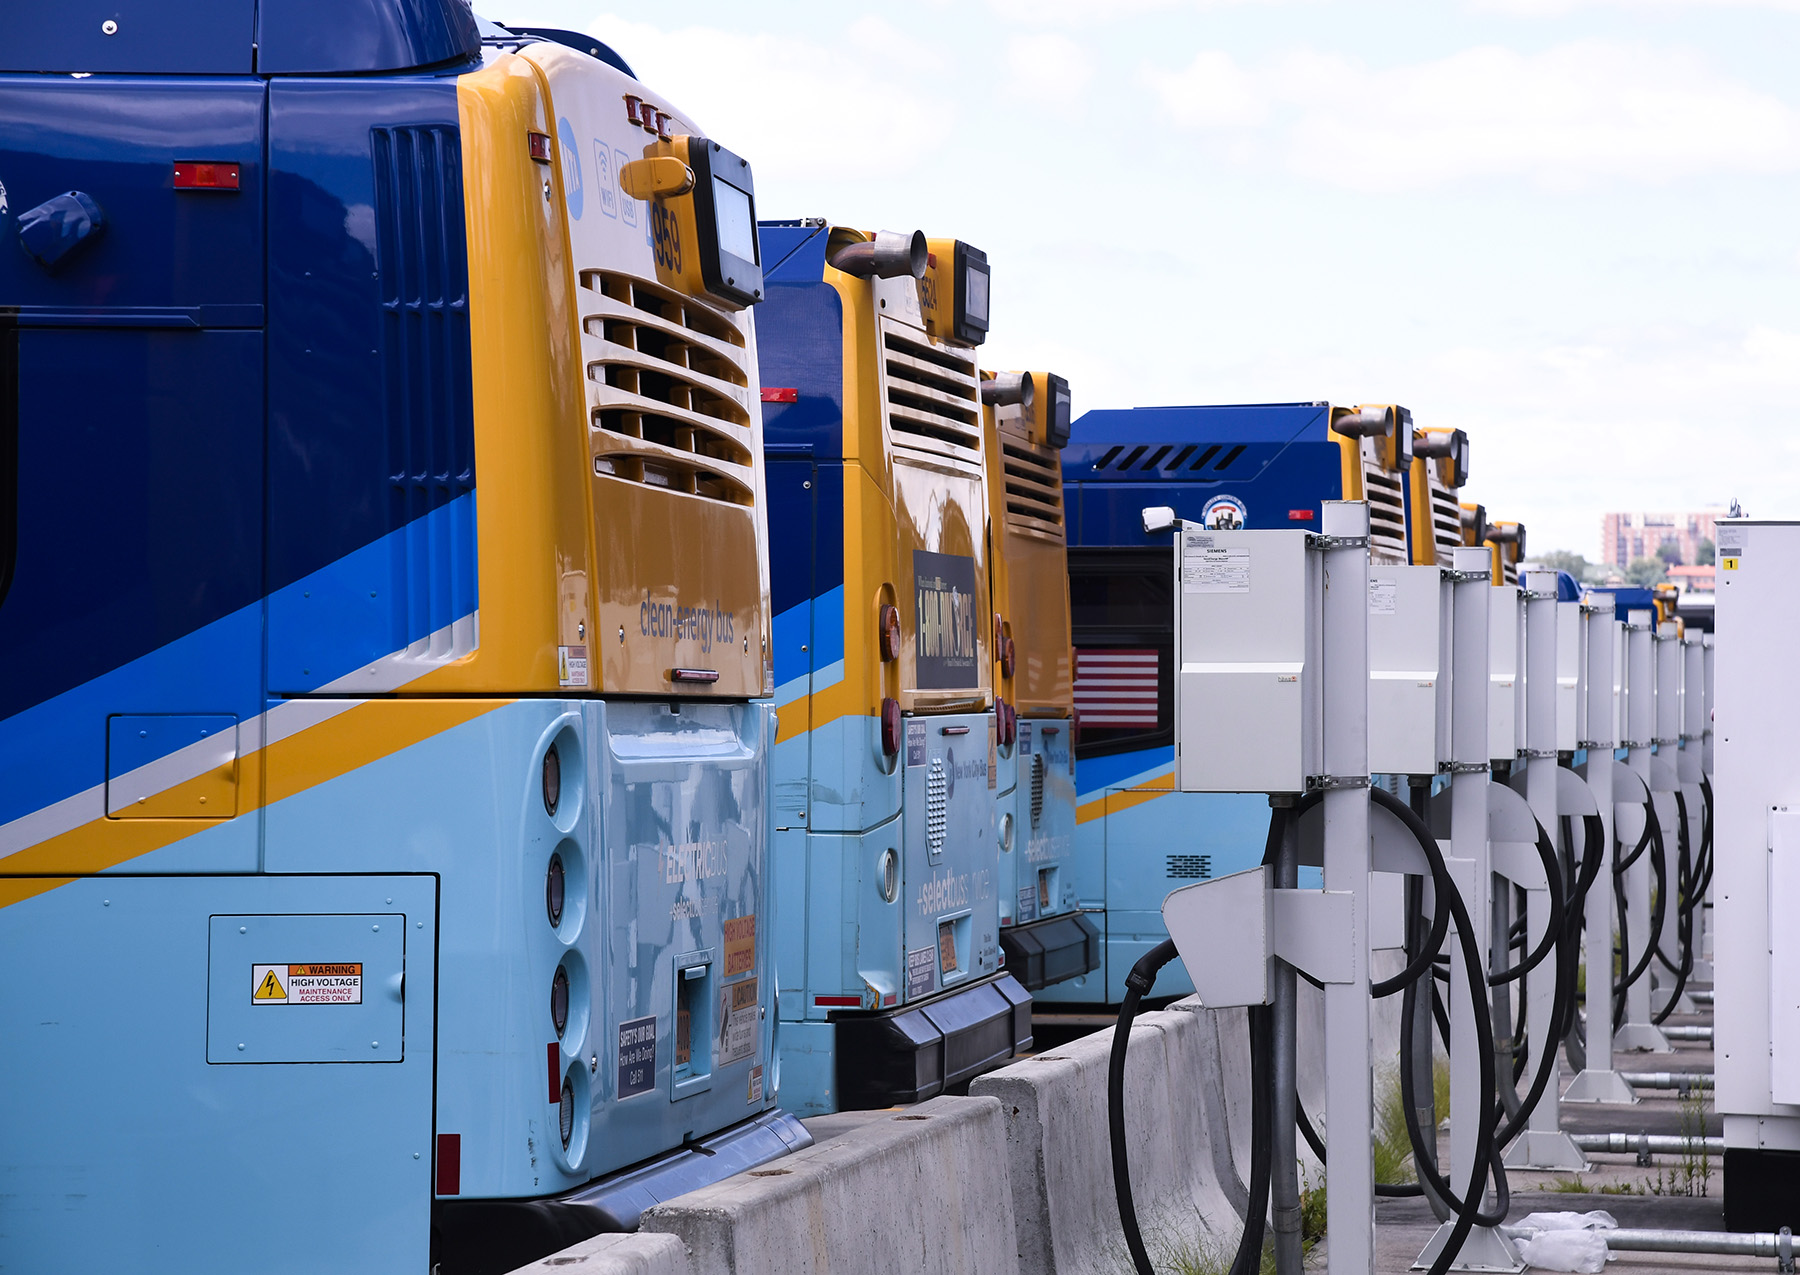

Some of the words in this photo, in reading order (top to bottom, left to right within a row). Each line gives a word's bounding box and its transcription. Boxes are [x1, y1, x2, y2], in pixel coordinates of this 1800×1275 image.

[1727, 560, 1733, 568] 1
[641, 590, 714, 653] clean-energy
[716, 600, 734, 644] bus
[955, 761, 963, 779] New
[963, 760, 971, 778] York
[309, 965, 355, 974] WARNING
[728, 948, 752, 973] BATTERIES
[291, 978, 314, 987] HIGH
[317, 978, 359, 986] VOLTAGE
[620, 1028, 637, 1047] SAFETY'S
[646, 1024, 655, 1040] GOAL
[620, 1052, 628, 1067] How
[635, 1048, 641, 1062] We
[642, 1044, 655, 1062] Doing?
